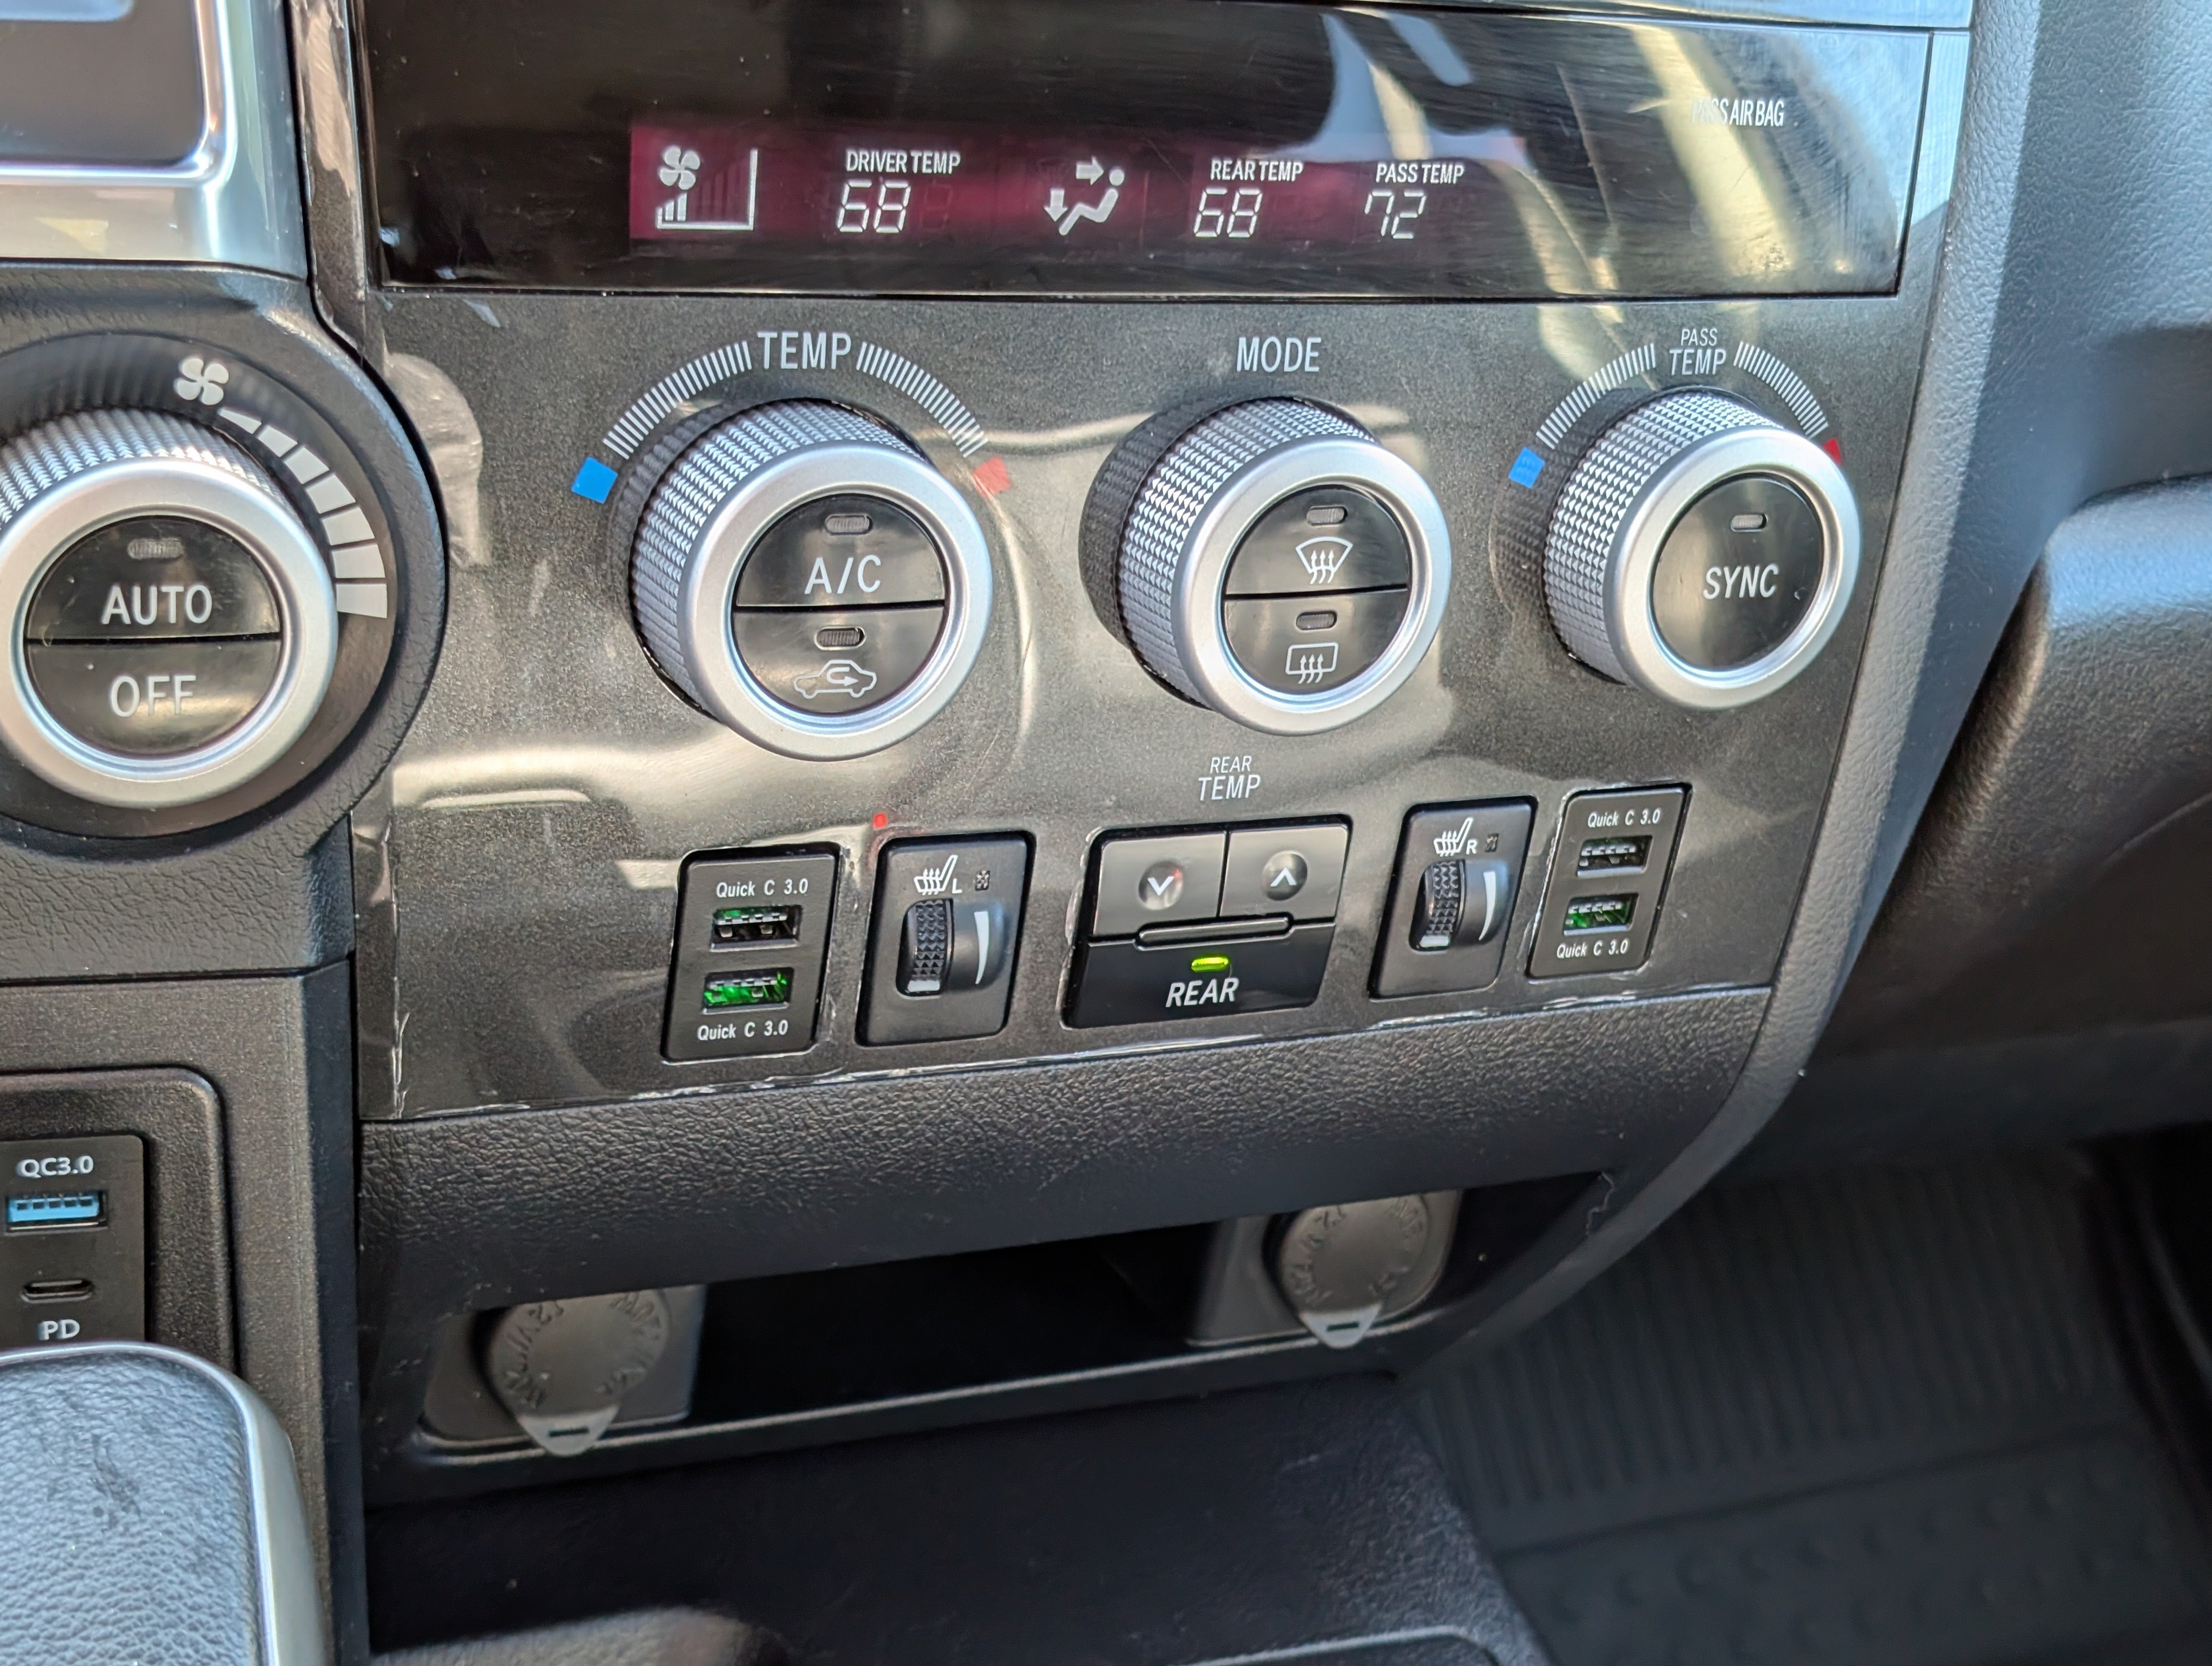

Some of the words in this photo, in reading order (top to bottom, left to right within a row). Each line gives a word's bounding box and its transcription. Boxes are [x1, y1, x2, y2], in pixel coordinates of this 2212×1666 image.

[1692, 98, 1729, 124] PASS
[845, 150, 908, 174] DRIVER
[911, 151, 961, 175] TEMP
[1210, 159, 1259, 182] REAR
[1259, 160, 1303, 183] TEMP
[1375, 162, 1418, 183] PASS
[1421, 163, 1465, 184] TEMP
[836, 179, 911, 234] 68
[1193, 187, 1263, 238] 68
[1364, 189, 1427, 239] 72
[1680, 327, 1718, 346] PASS
[757, 330, 852, 370] TEMP
[1236, 336, 1321, 372] MODE
[1669, 347, 1727, 376] TEMP
[804, 554, 882, 595] A/C
[1702, 562, 1779, 600] SYNC
[101, 585, 213, 625] AUTO
[110, 674, 197, 718] OFF
[1210, 755, 1252, 773] REAR
[1198, 773, 1261, 801] TEMP
[1587, 812, 1618, 829] Quick
[1624, 811, 1635, 825] C
[1639, 809, 1660, 824] 3.0
[1465, 839, 1477, 855] R
[716, 881, 756, 899] Quick
[763, 879, 775, 895] C
[783, 878, 809, 895] 3.0
[951, 878, 962, 894] L
[1556, 944, 1587, 959] Quick
[1593, 942, 1603, 956] C
[1608, 940, 1629, 955] 3.0
[1165, 977, 1240, 1008] REAR
[697, 1023, 737, 1041] Quick
[743, 1021, 756, 1037] C
[764, 1020, 789, 1036] 3.0
[17, 1155, 94, 1178] QC3.0
[39, 1319, 81, 1341] PD
